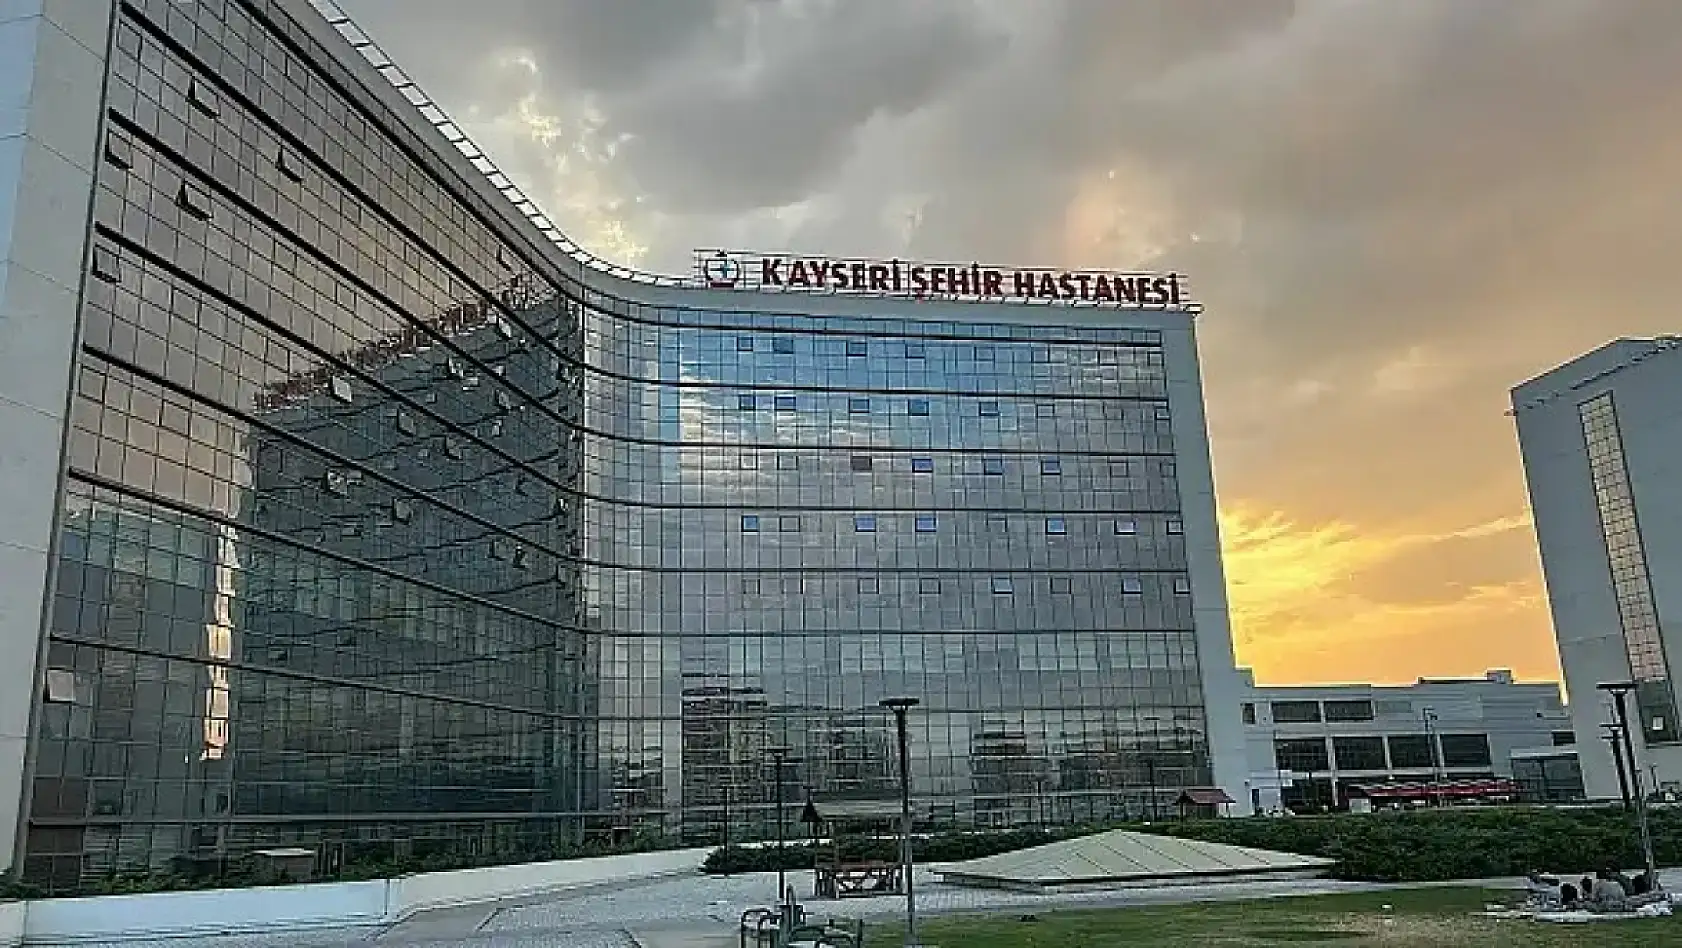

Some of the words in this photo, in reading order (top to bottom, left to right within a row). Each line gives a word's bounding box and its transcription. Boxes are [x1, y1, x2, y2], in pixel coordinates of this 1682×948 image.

[762, 257, 901, 291] KAYSERİ
[911, 261, 1003, 301] ŞEHİR
[1014, 273, 1180, 304] HASTANESİ
